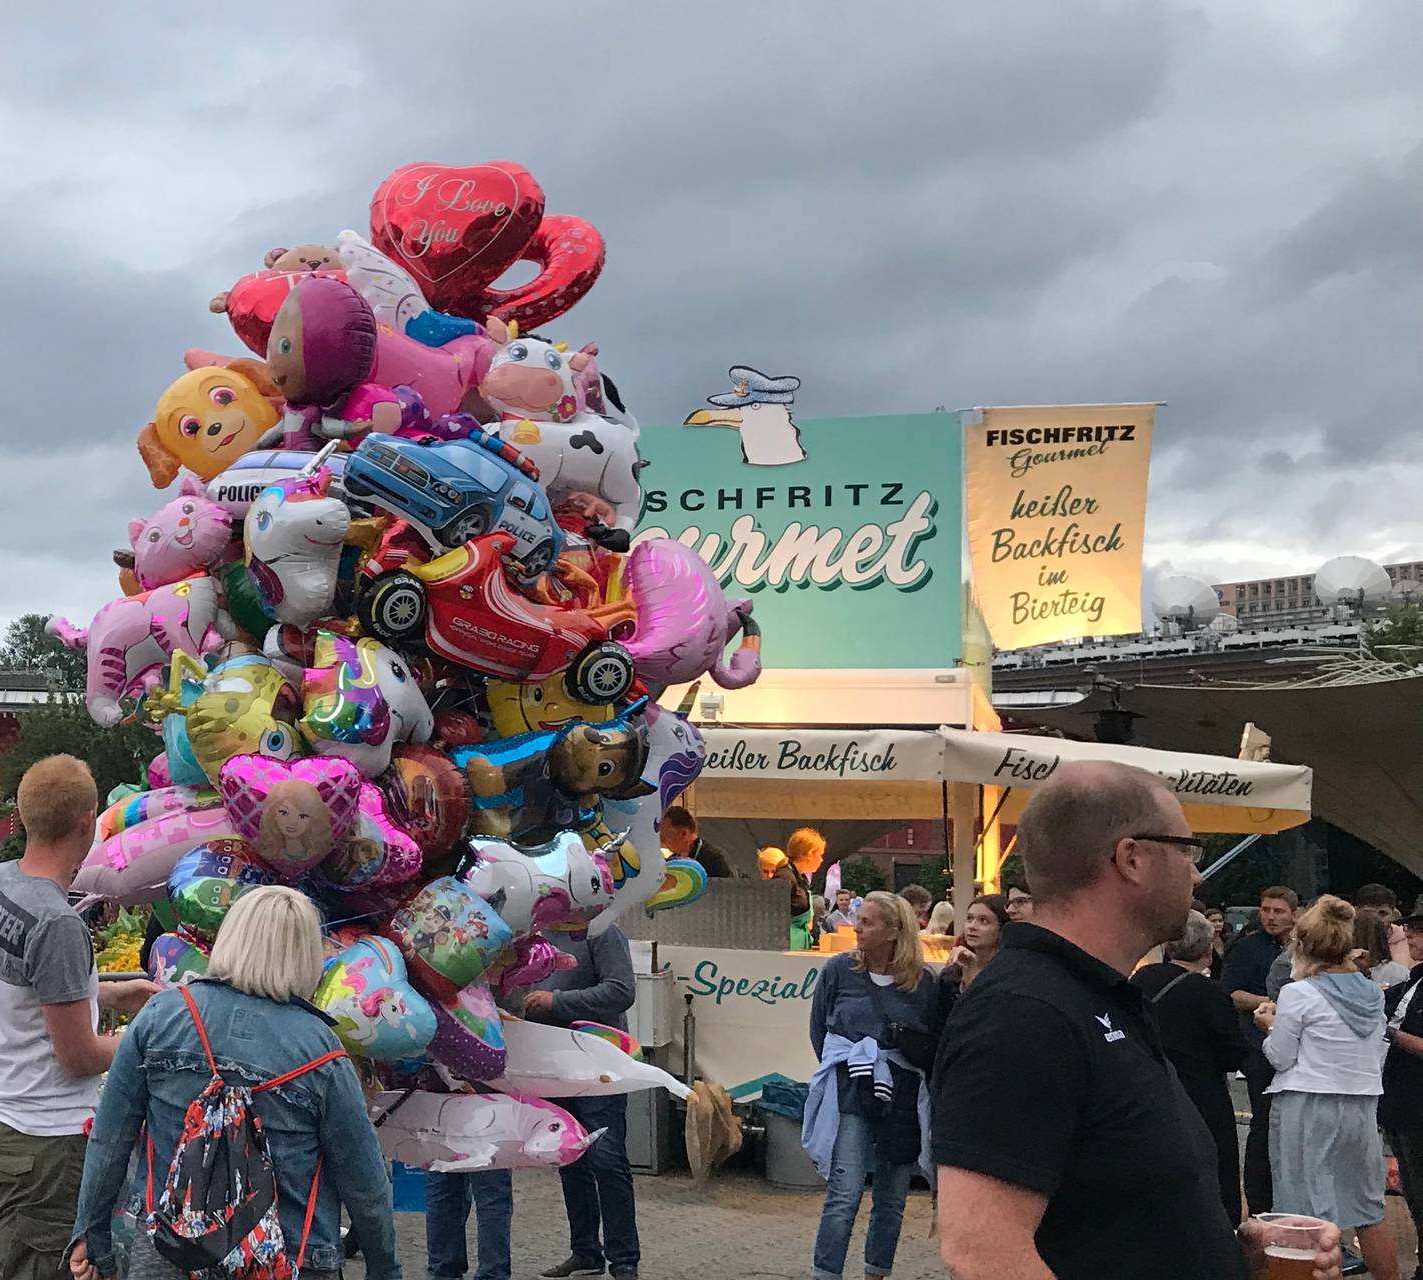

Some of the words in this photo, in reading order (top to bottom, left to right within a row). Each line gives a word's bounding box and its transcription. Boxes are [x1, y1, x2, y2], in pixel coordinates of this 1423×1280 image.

[395, 173, 439, 207] I
[434, 179, 506, 216] Love
[401, 219, 458, 258] You
[986, 425, 1136, 447] FISCHFRITZ
[1006, 437, 1110, 478] Gourmet
[646, 483, 904, 512] SCHFRITZ
[1010, 484, 1100, 520] heißer
[499, 520, 536, 544] POLICE
[627, 490, 935, 590] urmet
[991, 523, 1126, 563] Backfisch
[1038, 565, 1070, 586] im
[1009, 589, 1106, 625] Bierteig
[498, 635, 540, 653] RACING
[704, 740, 769, 771] eißer
[777, 740, 897, 777] Backfisch
[1166, 769, 1253, 797] litäten
[664, 960, 819, 1005] -Spezial
